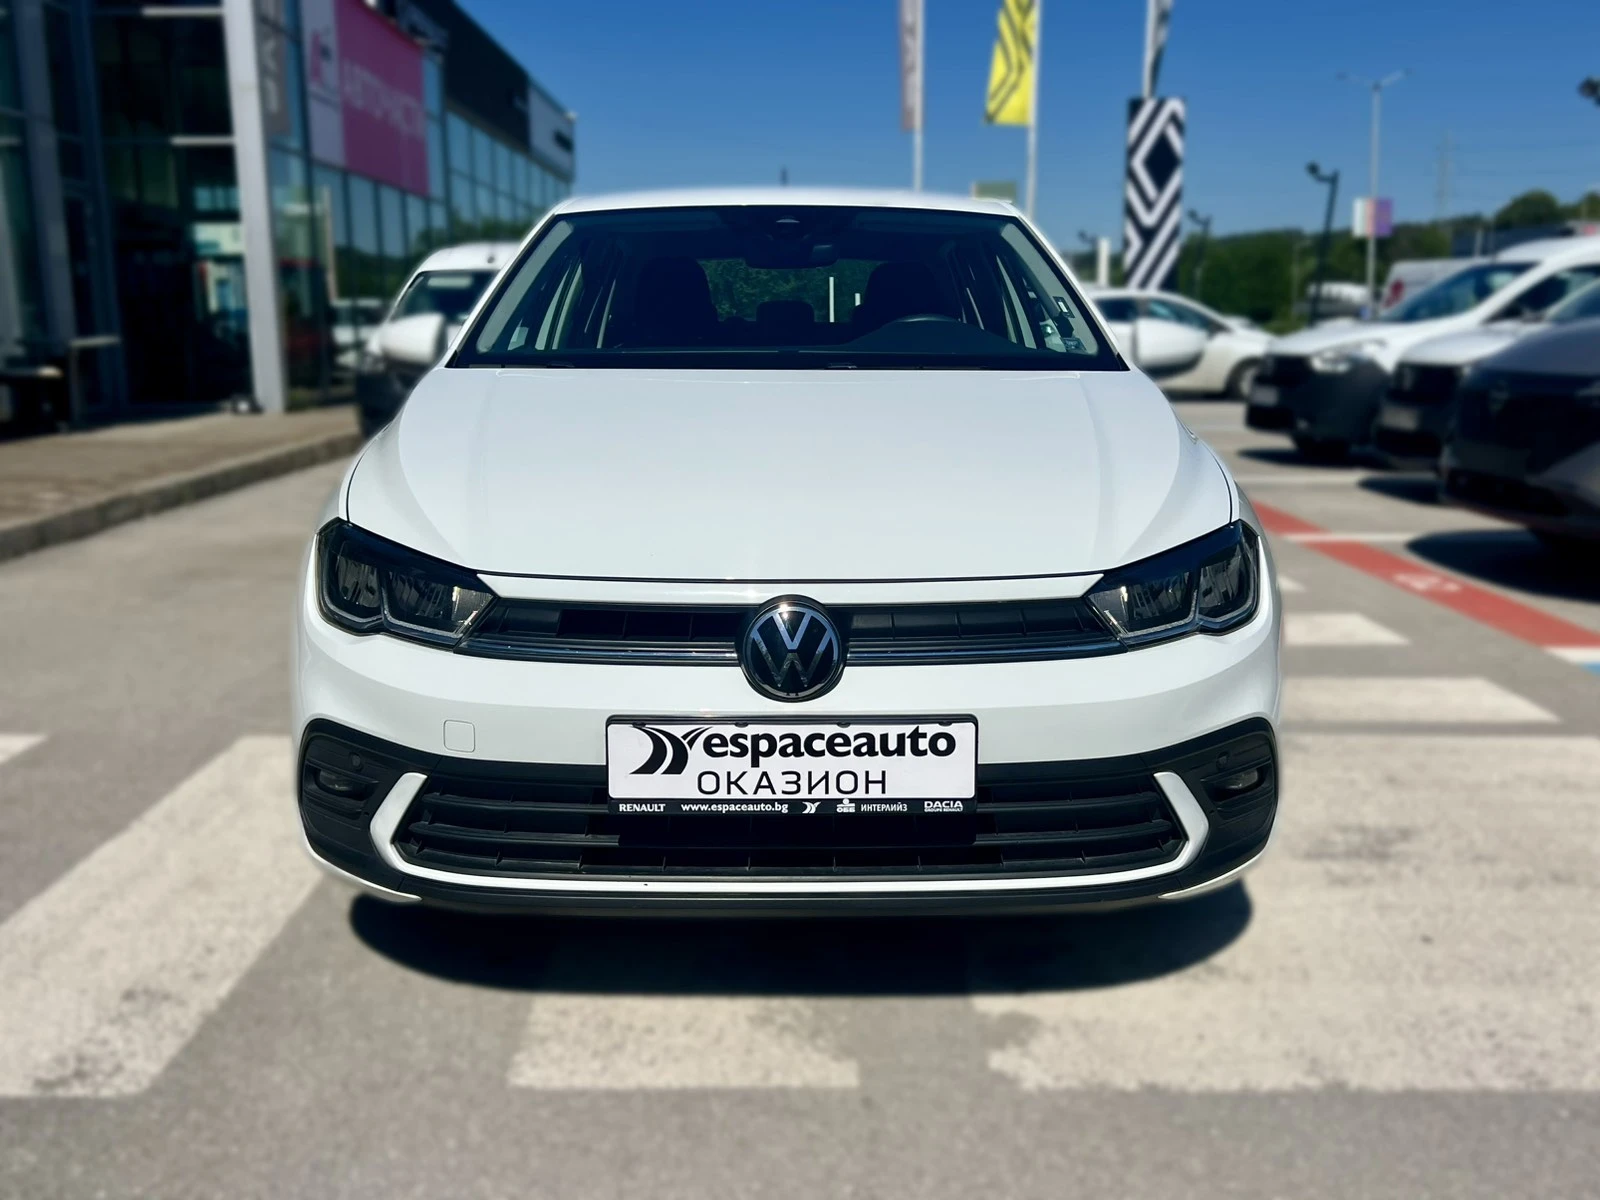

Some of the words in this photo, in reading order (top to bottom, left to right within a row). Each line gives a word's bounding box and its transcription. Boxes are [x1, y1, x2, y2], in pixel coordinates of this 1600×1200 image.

[702, 725, 957, 769] espaceauto
[697, 770, 887, 796] ОКАЗИОН
[618, 803, 666, 812] RENAULT
[680, 802, 789, 814] www.espaceauto.bg
[860, 801, 908, 812] ИНТЕРЛИЙЗ
[923, 800, 964, 808] DACIA
